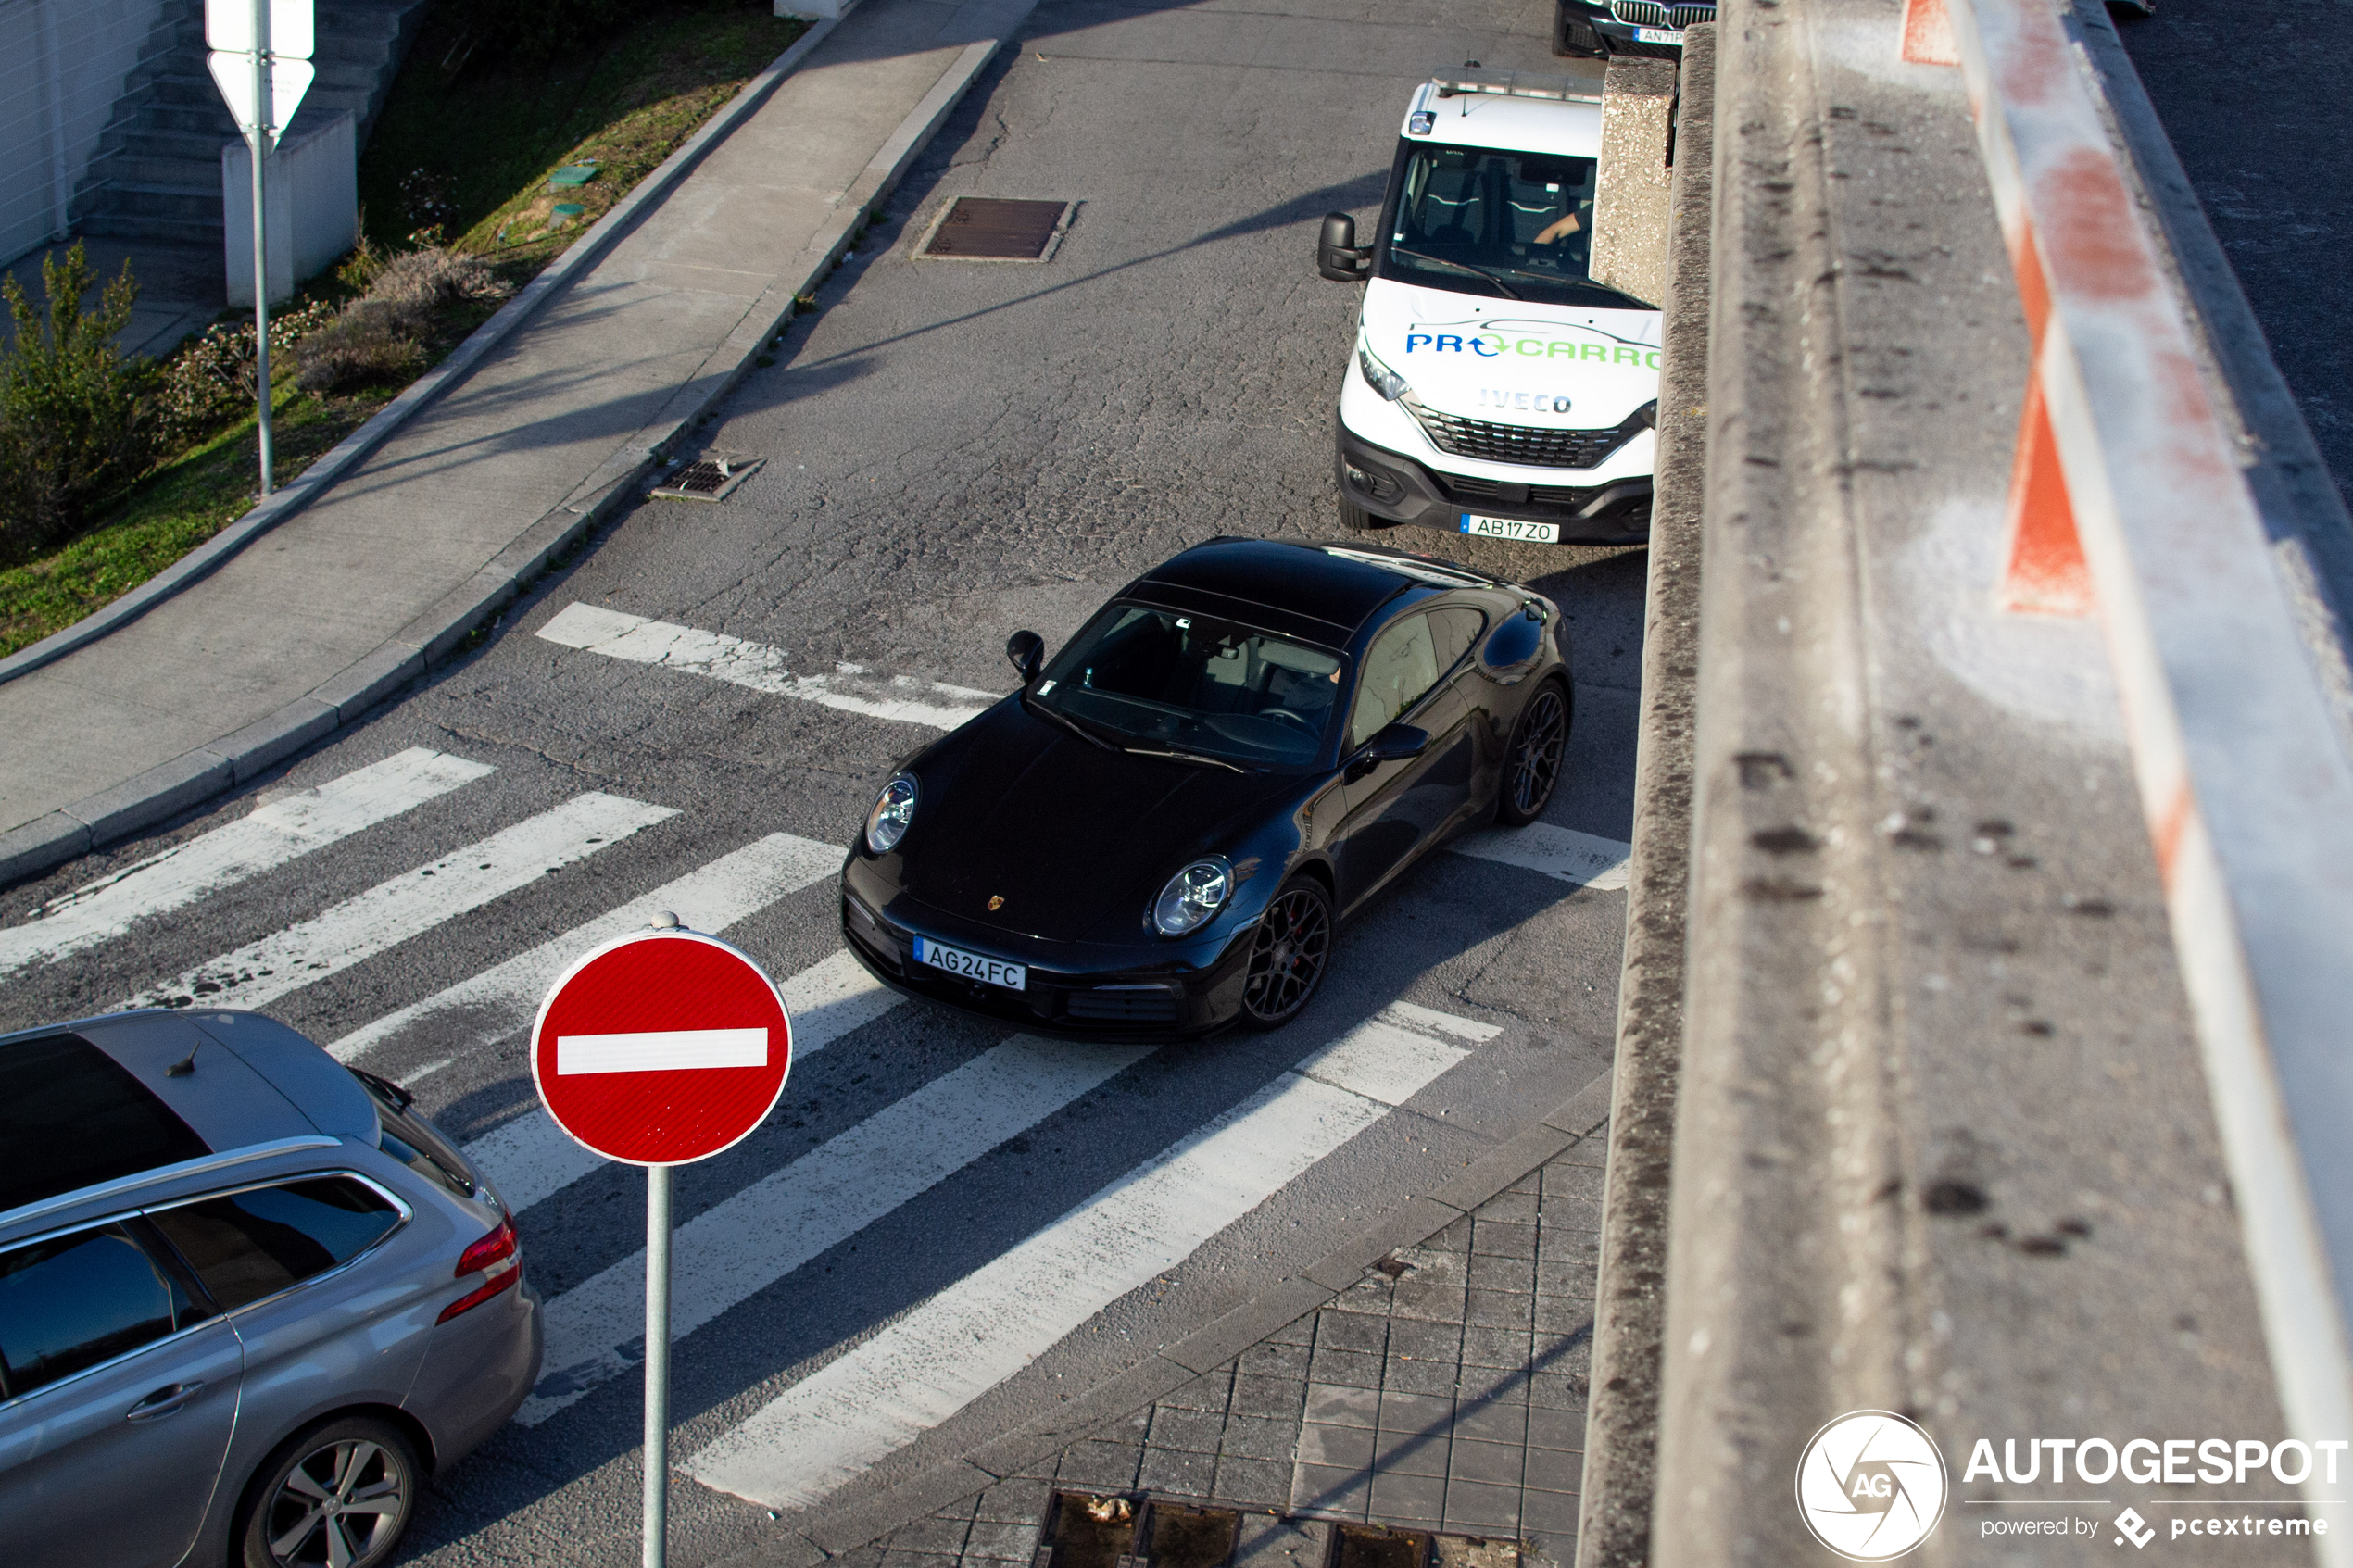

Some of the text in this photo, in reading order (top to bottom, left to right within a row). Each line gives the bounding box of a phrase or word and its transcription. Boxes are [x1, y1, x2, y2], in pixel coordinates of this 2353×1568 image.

[1644, 31, 1683, 44] AN71P
[1479, 388, 1573, 414] IVECO
[1478, 519, 1551, 540] AB17ZO
[929, 946, 1018, 986] AG24FC
